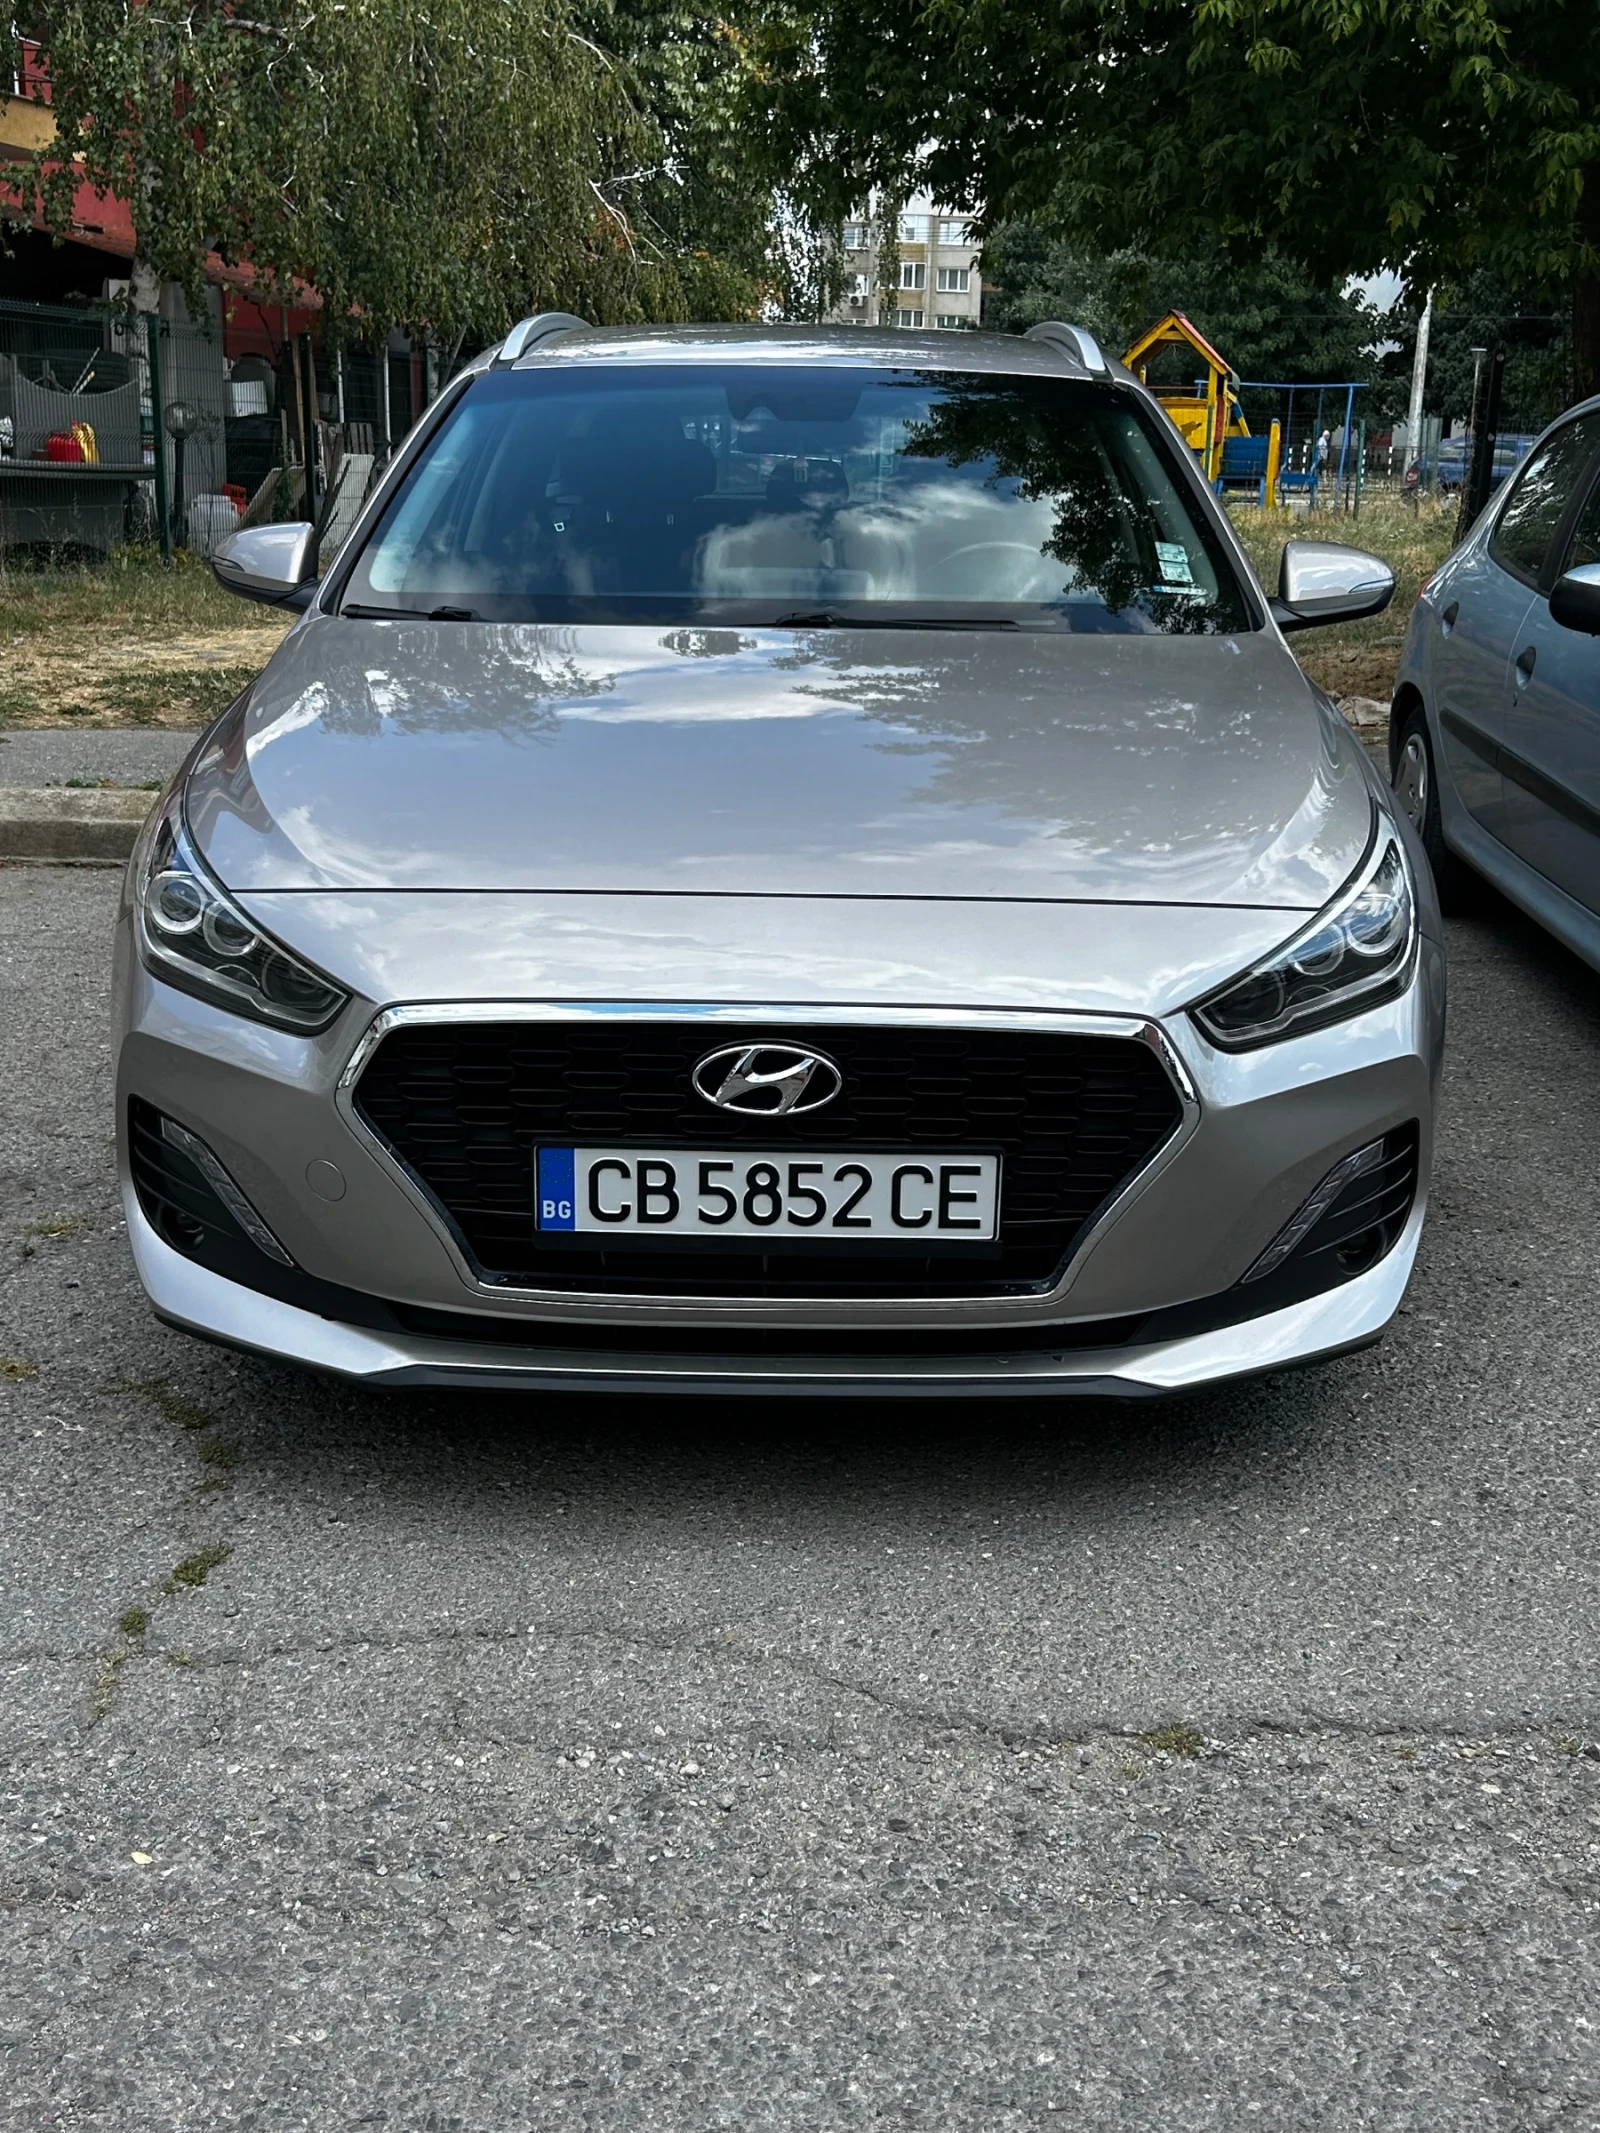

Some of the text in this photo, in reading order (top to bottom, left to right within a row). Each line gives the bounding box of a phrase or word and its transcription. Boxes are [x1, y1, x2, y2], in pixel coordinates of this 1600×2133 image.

[542, 1200, 572, 1219] BG
[588, 1158, 982, 1230] CB 5852 CE
